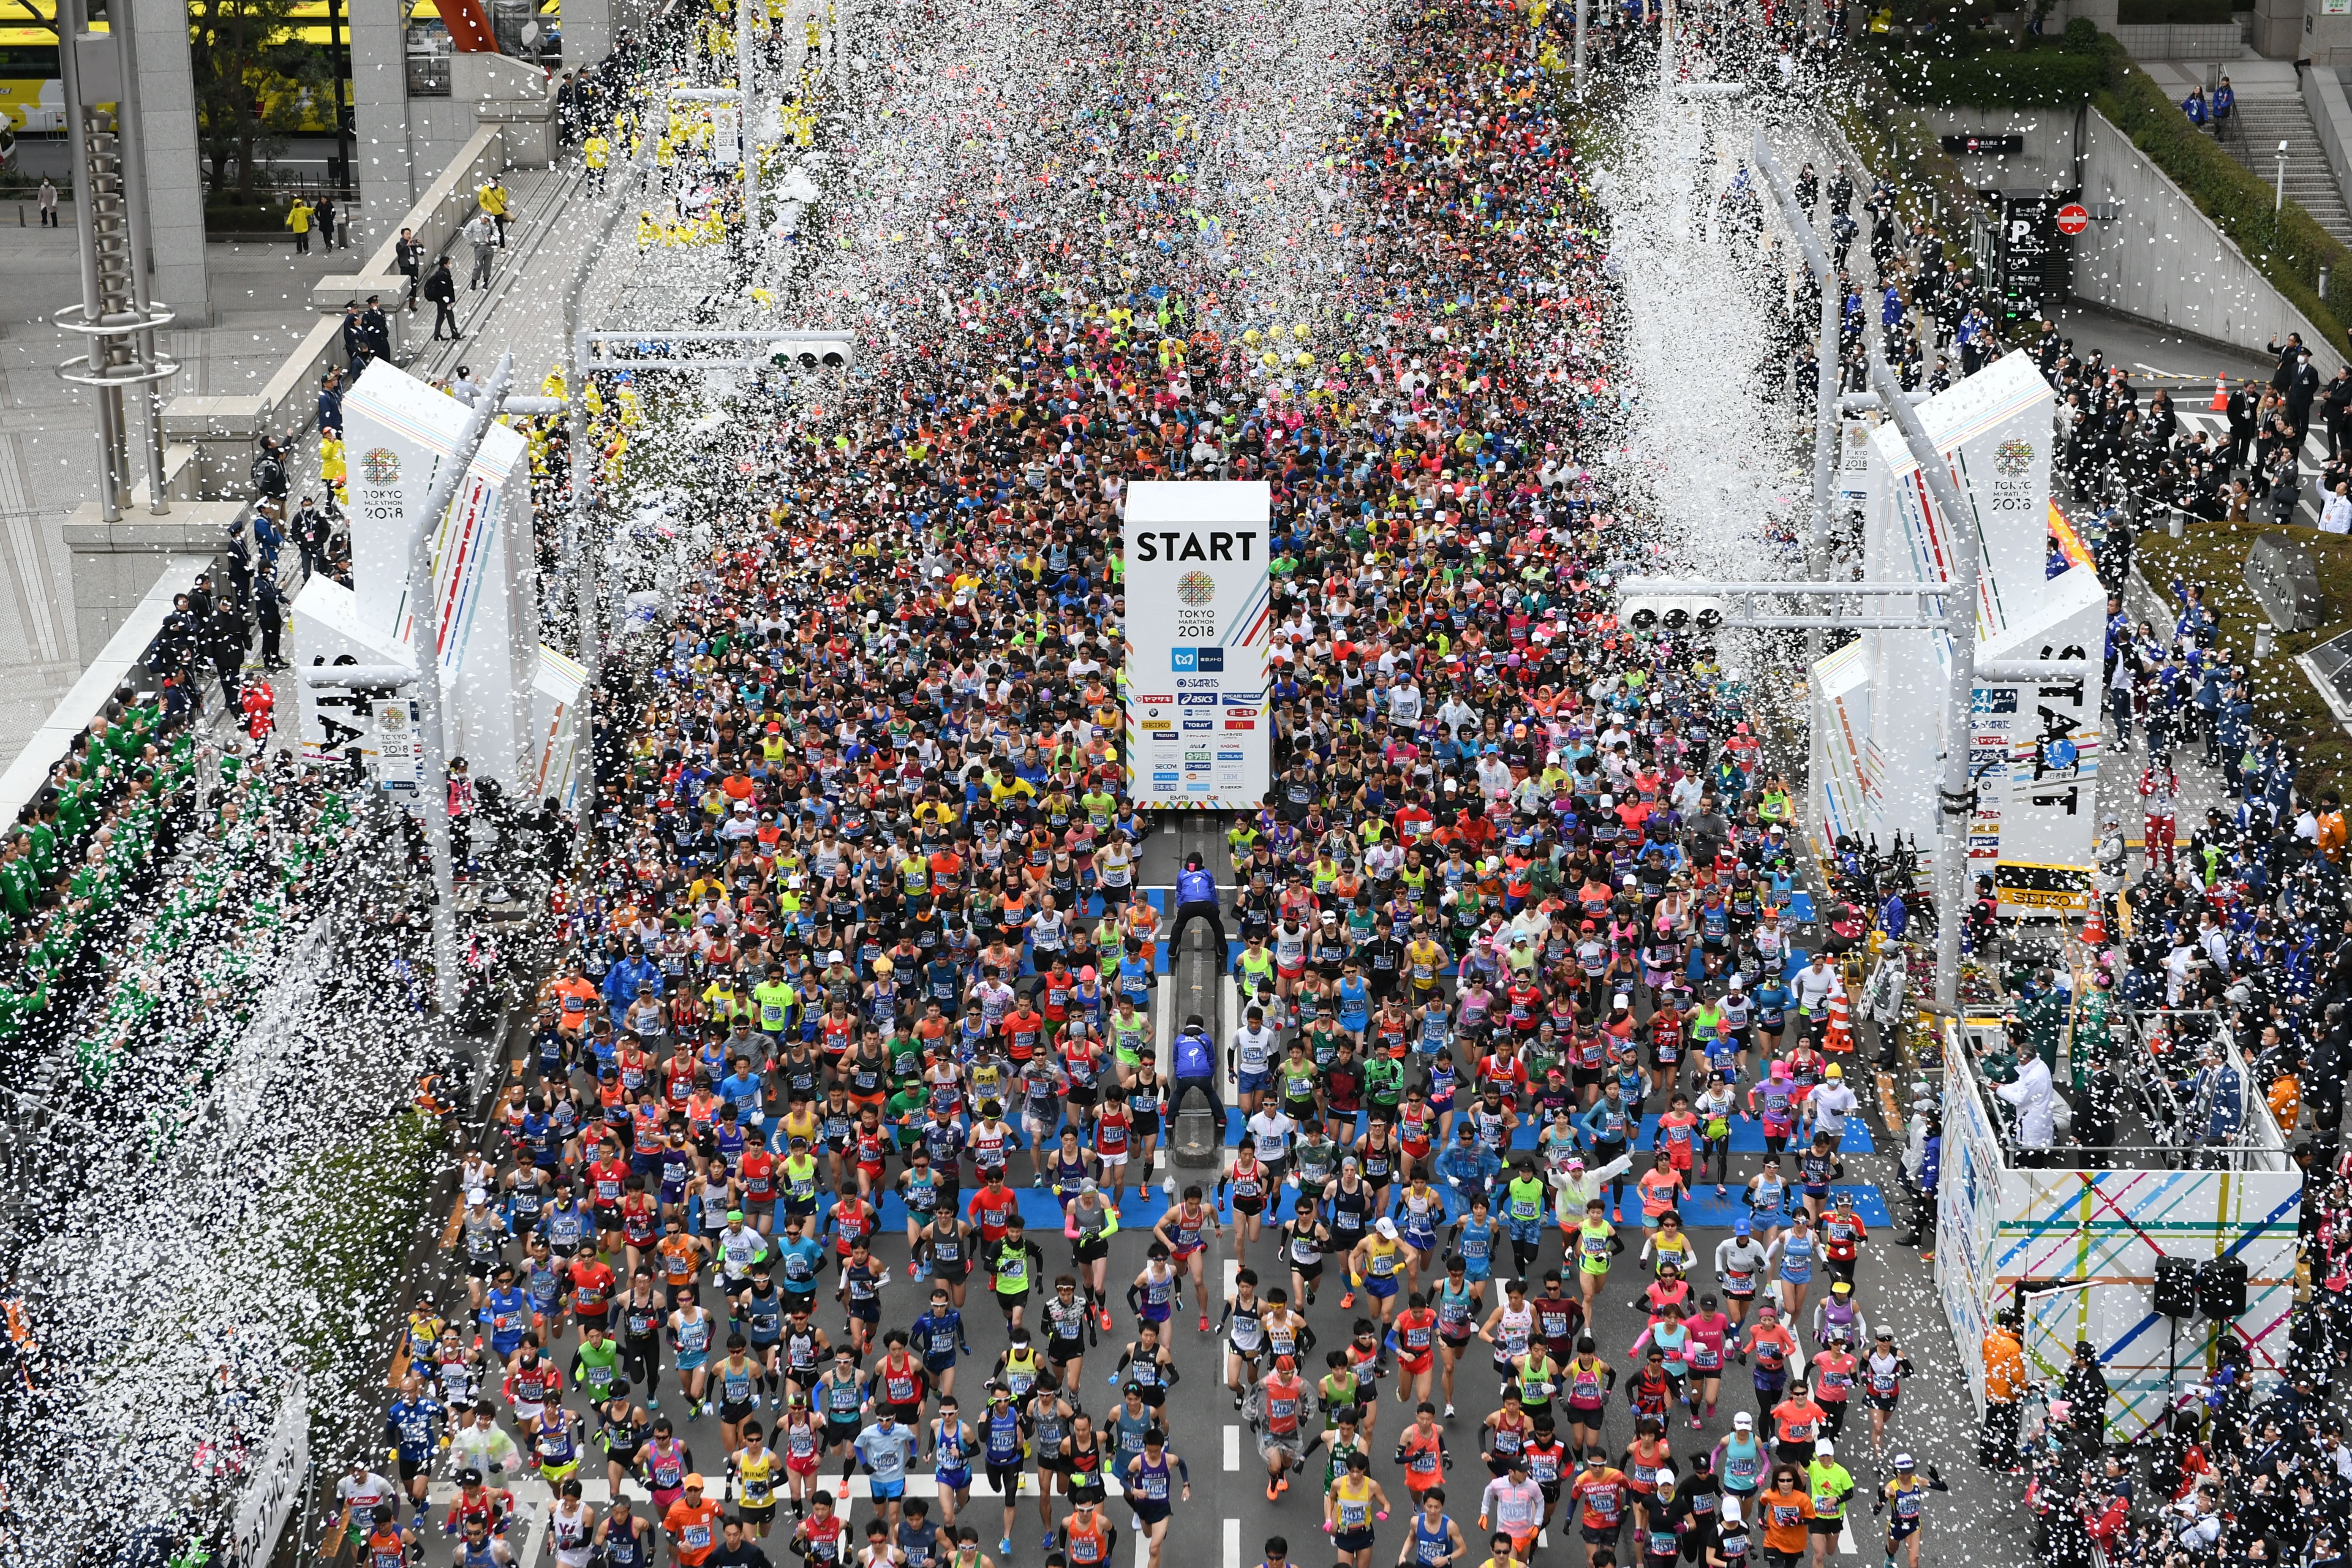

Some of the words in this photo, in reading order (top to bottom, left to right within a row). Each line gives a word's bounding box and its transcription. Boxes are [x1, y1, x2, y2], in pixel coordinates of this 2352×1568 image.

[2012, 220, 2031, 243] P
[365, 507, 403, 519] 2018
[1137, 532, 1256, 561] START
[1178, 610, 1214, 618] TOKYO
[1178, 626, 1214, 637] 2018
[2013, 893, 2071, 907] SEIKO
[1149, 1292, 1168, 1300] A4230
[1408, 1333, 1429, 1341] A4236
[1134, 1372, 1152, 1380] A4056
[833, 1395, 854, 1403] A4320
[1496, 1440, 1516, 1450] A4062
[874, 1458, 896, 1467] A4060
[1531, 1455, 1557, 1463] MHPS
[1533, 1468, 1553, 1476] A4790
[1143, 1485, 1164, 1494] A4402
[1342, 1511, 1361, 1519] A4439
[1074, 1547, 1094, 1556] A4403
[1420, 1546, 1441, 1557] A4565
